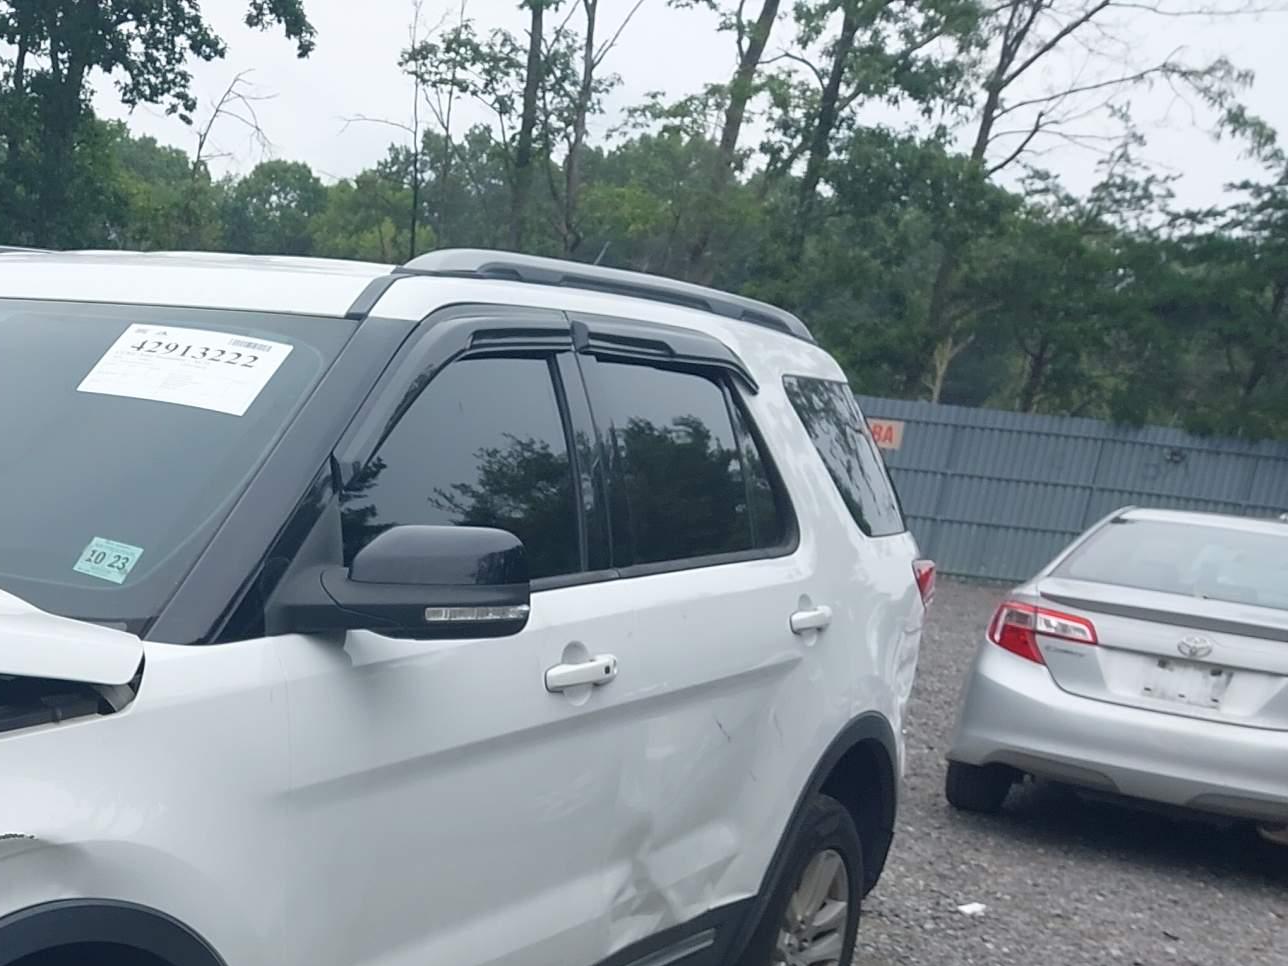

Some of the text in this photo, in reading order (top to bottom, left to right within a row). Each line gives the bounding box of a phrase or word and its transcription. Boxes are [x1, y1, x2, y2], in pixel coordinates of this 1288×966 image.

[130, 339, 260, 369] 42913222
[84, 549, 107, 565] 10
[107, 554, 130, 571] 23
